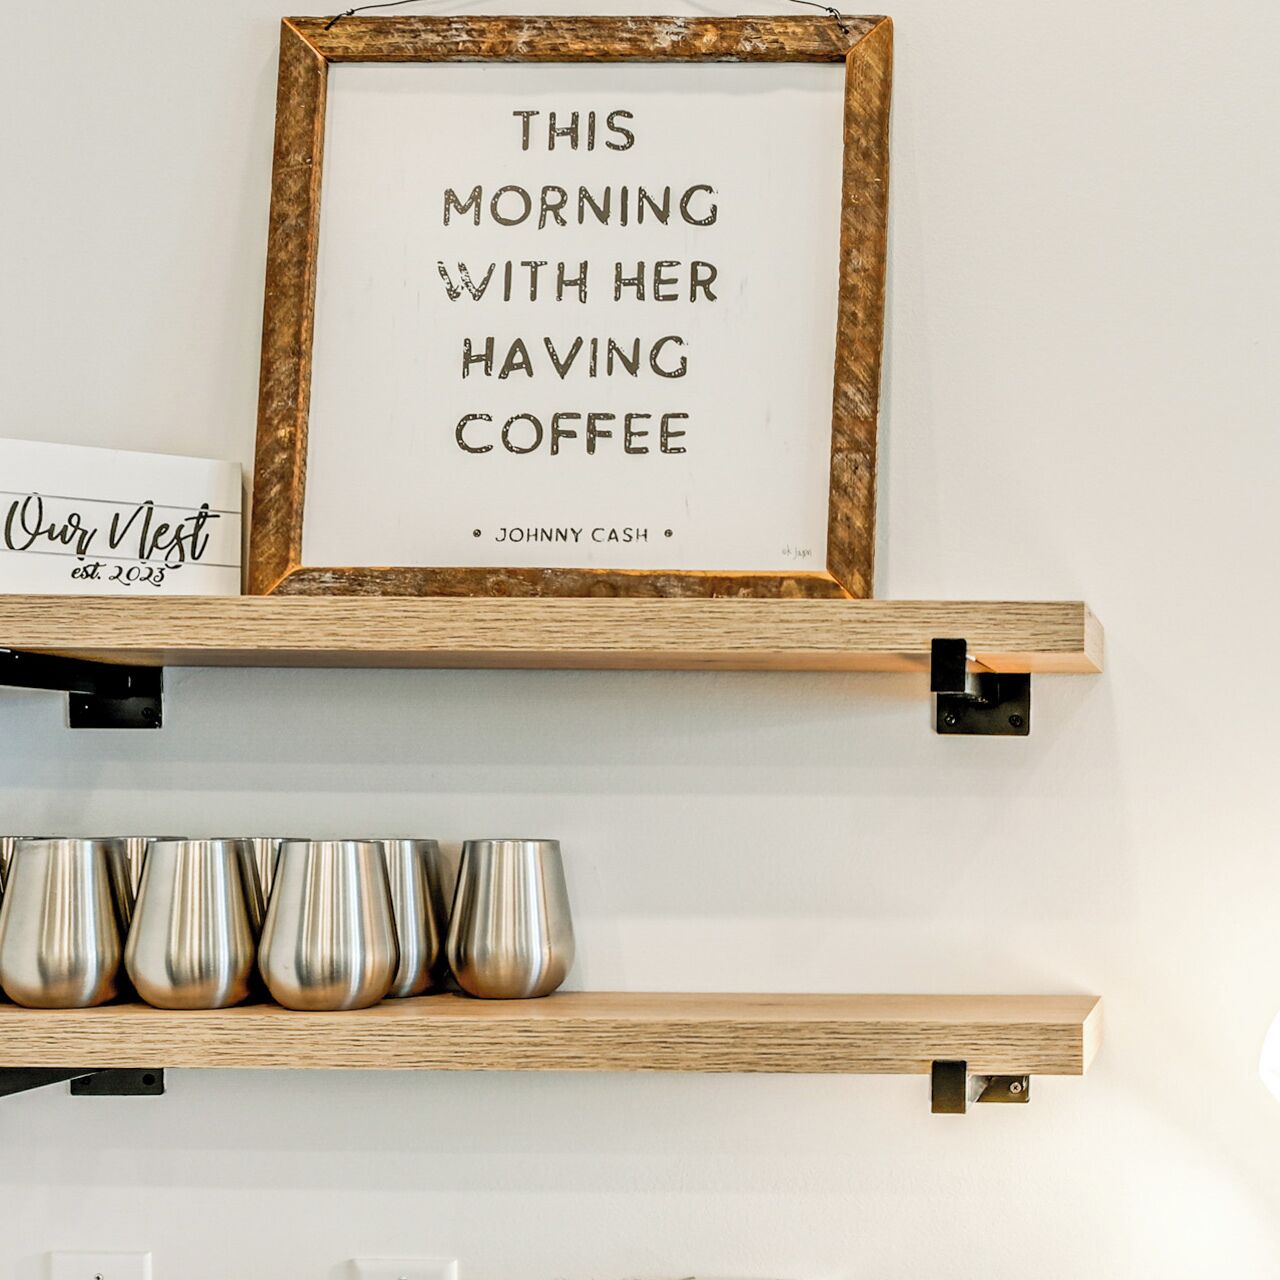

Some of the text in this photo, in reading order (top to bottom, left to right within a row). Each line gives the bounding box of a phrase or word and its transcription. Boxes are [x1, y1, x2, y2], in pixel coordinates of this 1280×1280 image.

[513, 109, 636, 151] THIS
[442, 184, 718, 230] MORNING
[437, 260, 718, 303] WITH HER
[462, 335, 688, 379] HAVING
[455, 412, 689, 455] COFFEE
[4, 492, 220, 570] Our Nest
[495, 527, 649, 543] JOHNNY CASH
[71, 561, 167, 587] est. 2023
